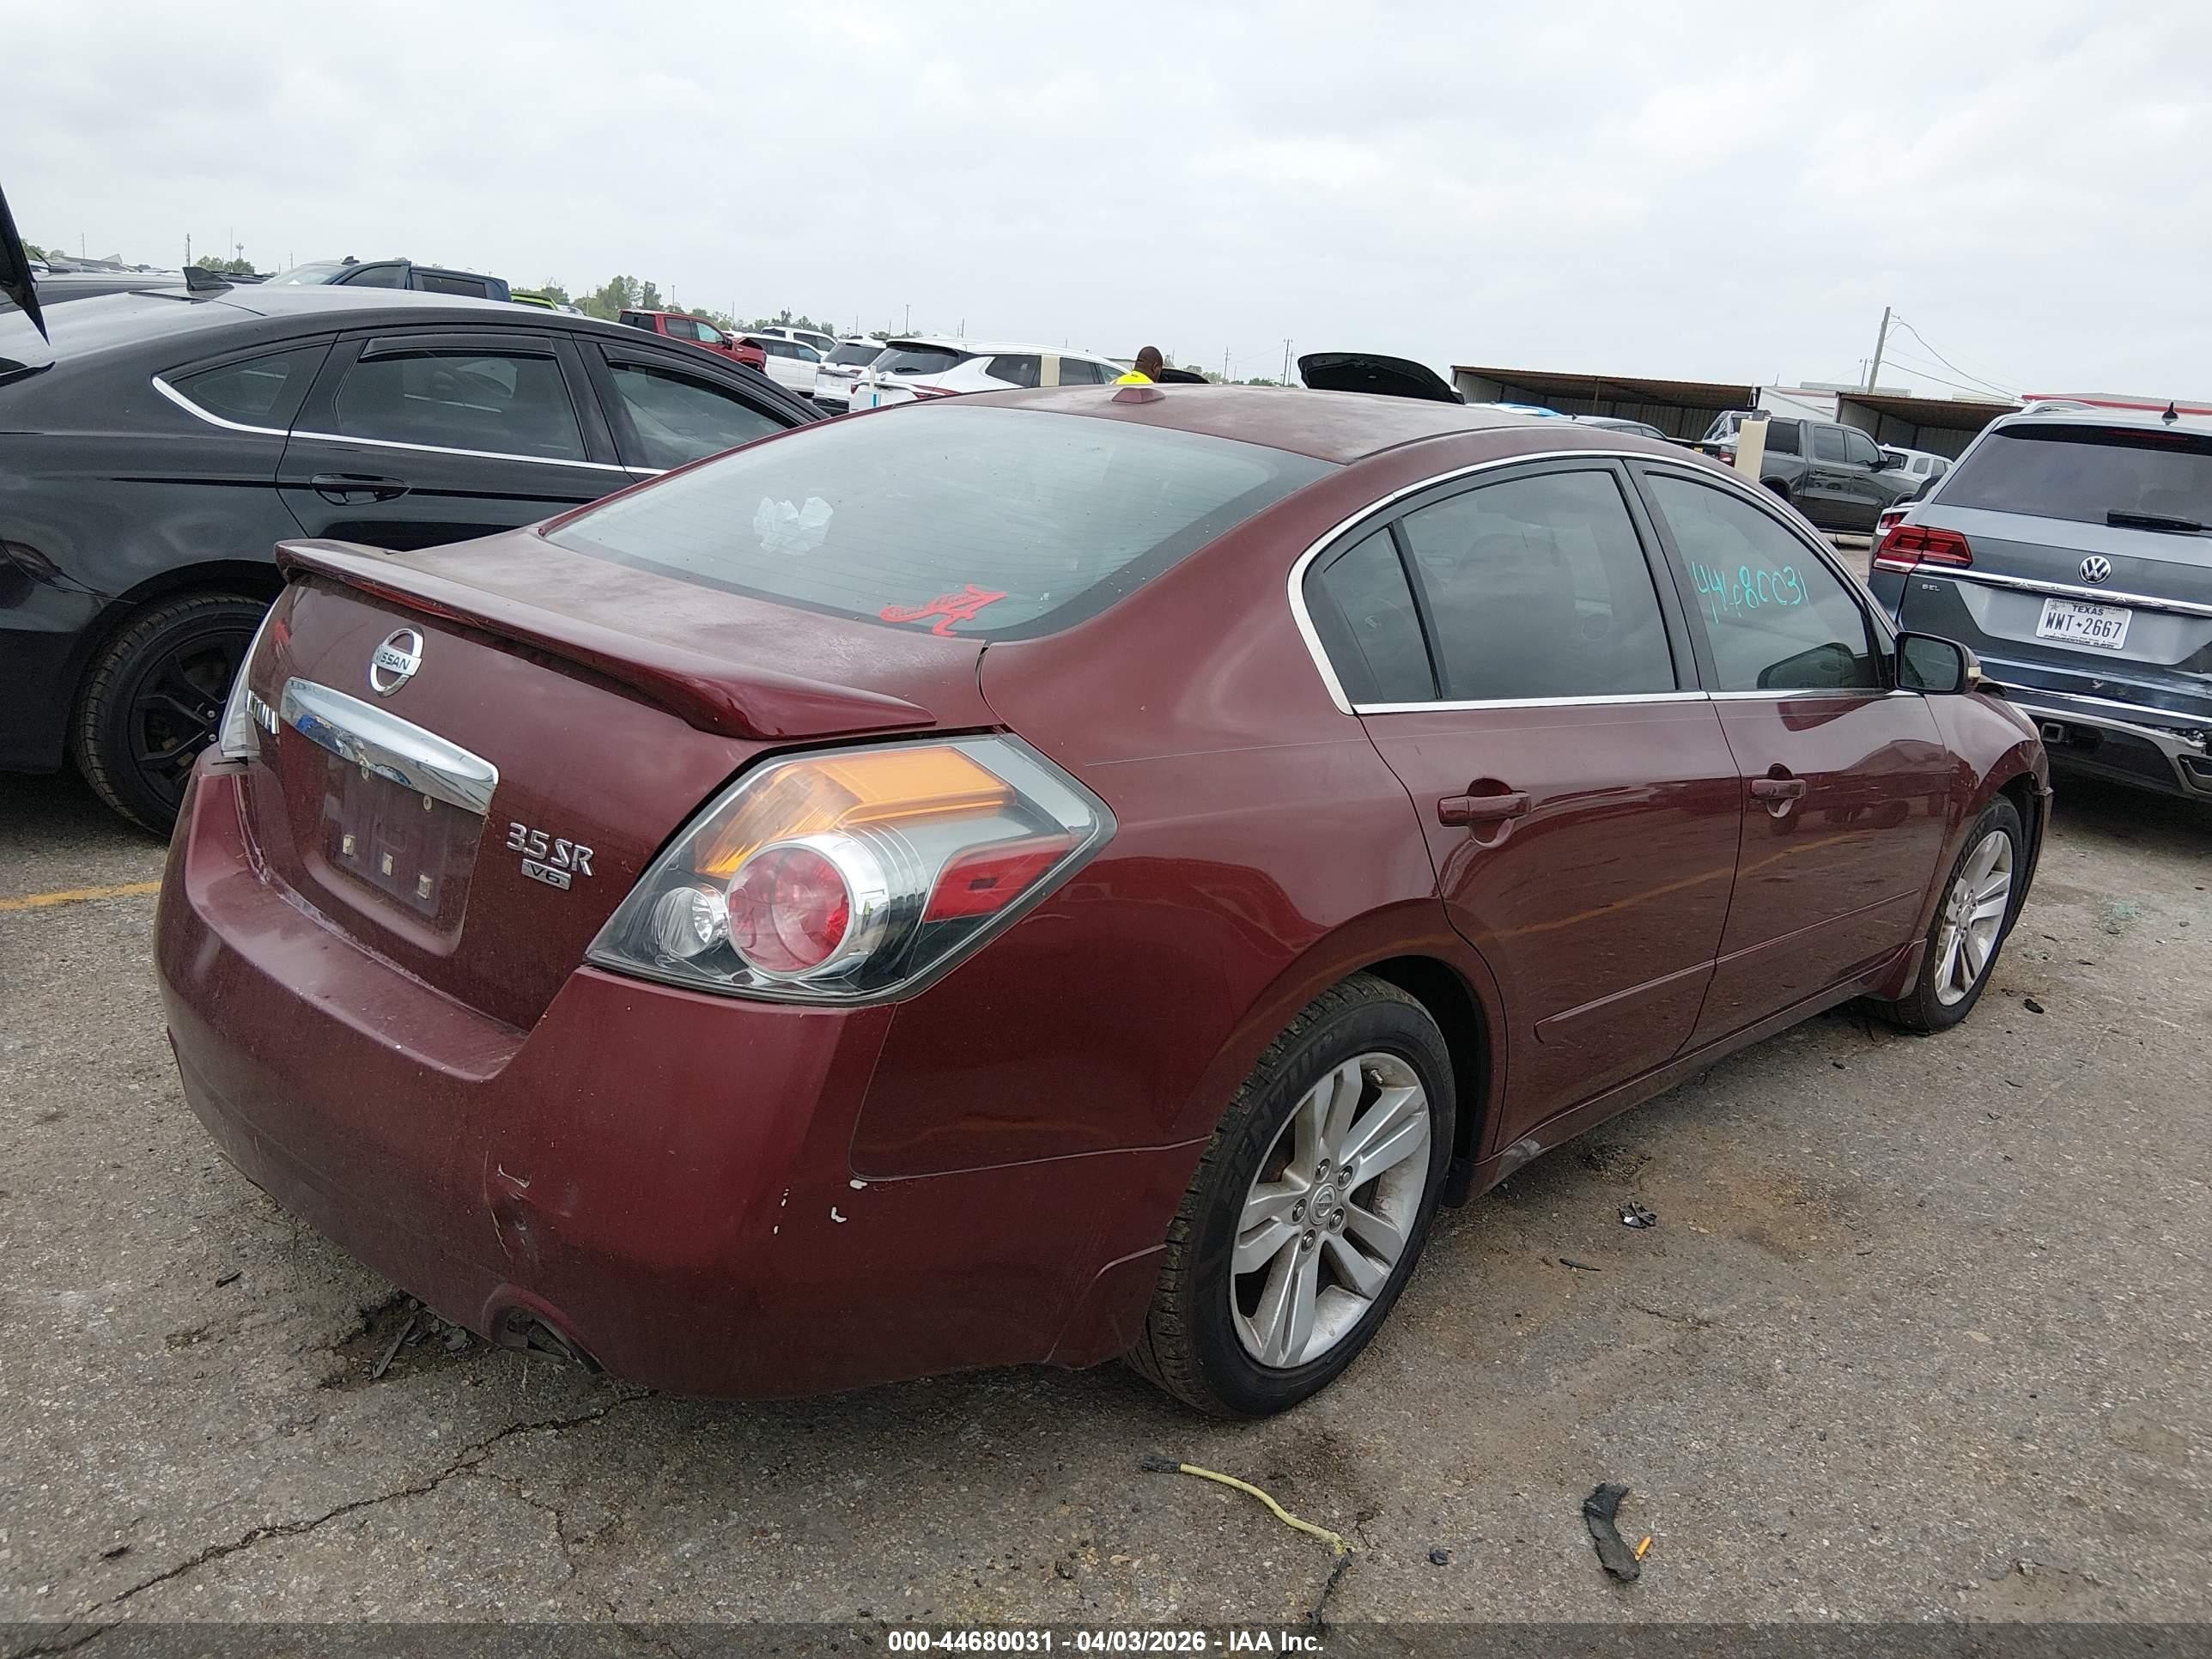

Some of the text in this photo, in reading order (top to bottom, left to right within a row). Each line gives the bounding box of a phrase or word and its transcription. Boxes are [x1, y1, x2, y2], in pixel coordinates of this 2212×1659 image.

[2072, 605, 2104, 616] TEXAS
[550, 838, 594, 877] SR
[528, 862, 561, 884] V6
